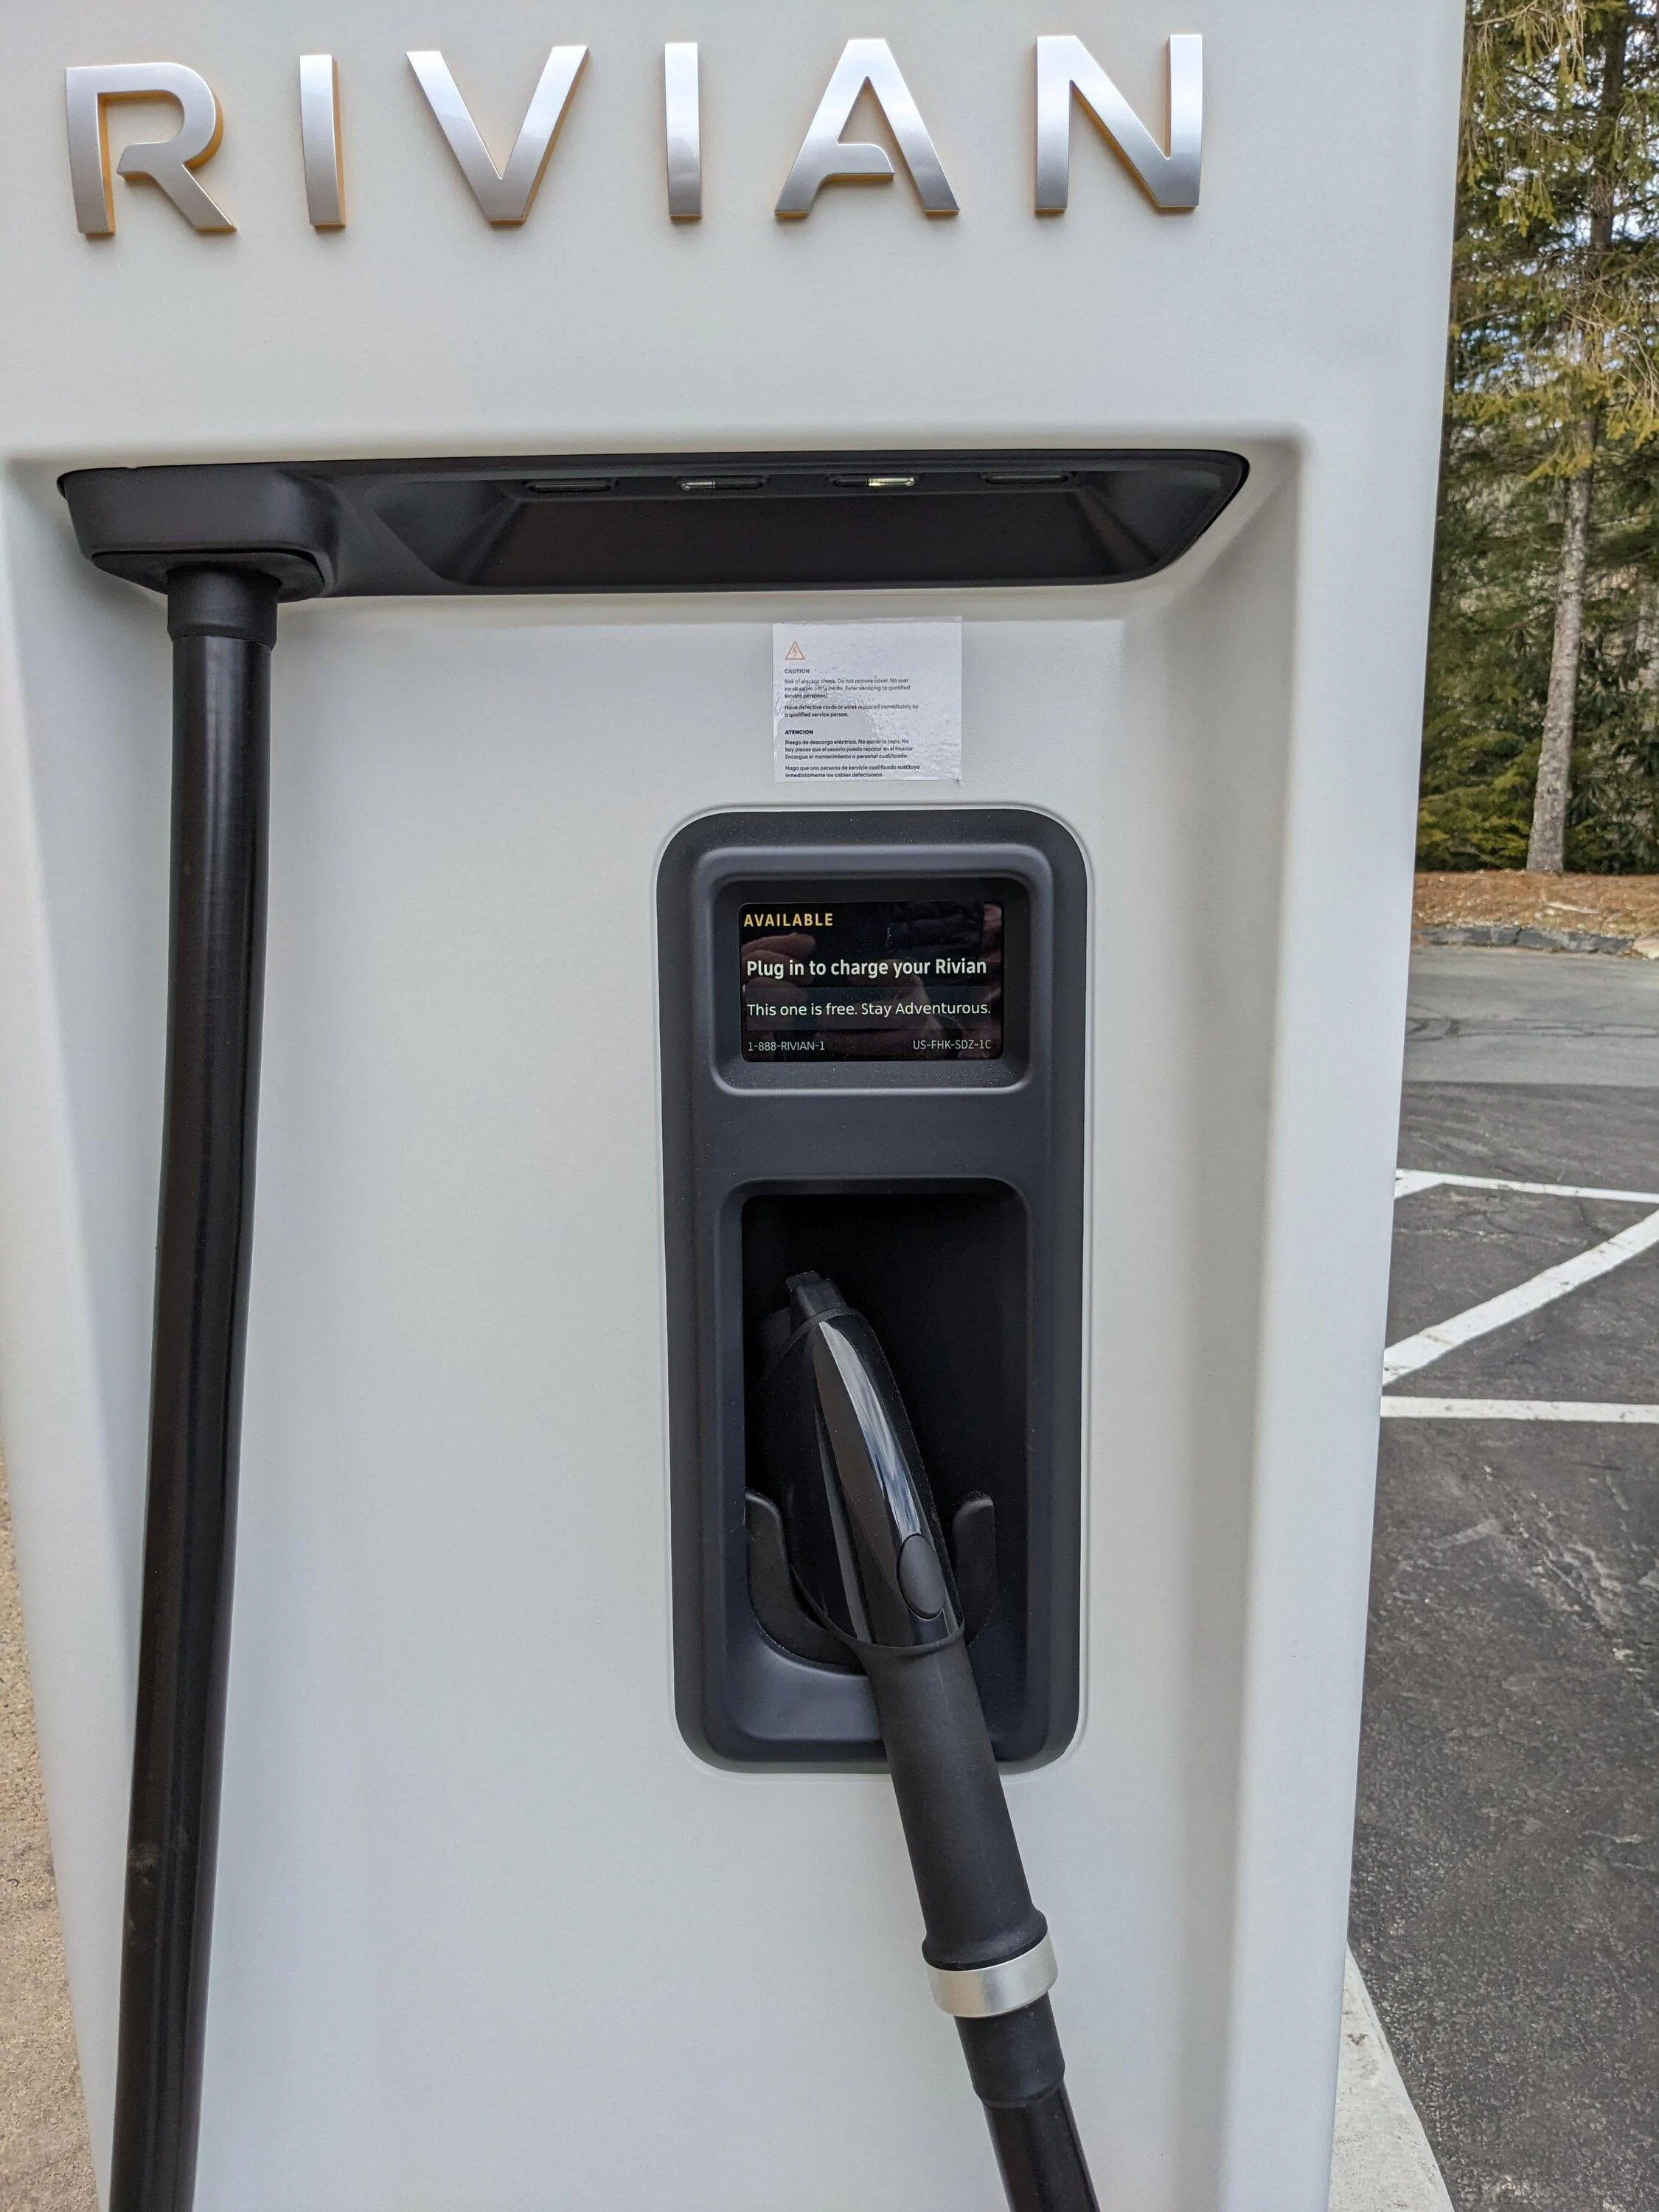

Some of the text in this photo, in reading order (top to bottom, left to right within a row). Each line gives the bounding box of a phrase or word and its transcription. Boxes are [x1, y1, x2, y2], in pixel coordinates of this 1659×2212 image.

[64, 33, 1203, 236] RIVIAN
[743, 913, 833, 927] AVAILABLE
[746, 958, 987, 979] Plug in to charge your Rivian
[747, 1001, 991, 1018] This one is free. Stay Adventurous.
[748, 1040, 825, 1051] 1-888-RIVIAN-1
[913, 1039, 991, 1050] US-FHK-SDZ-1C
